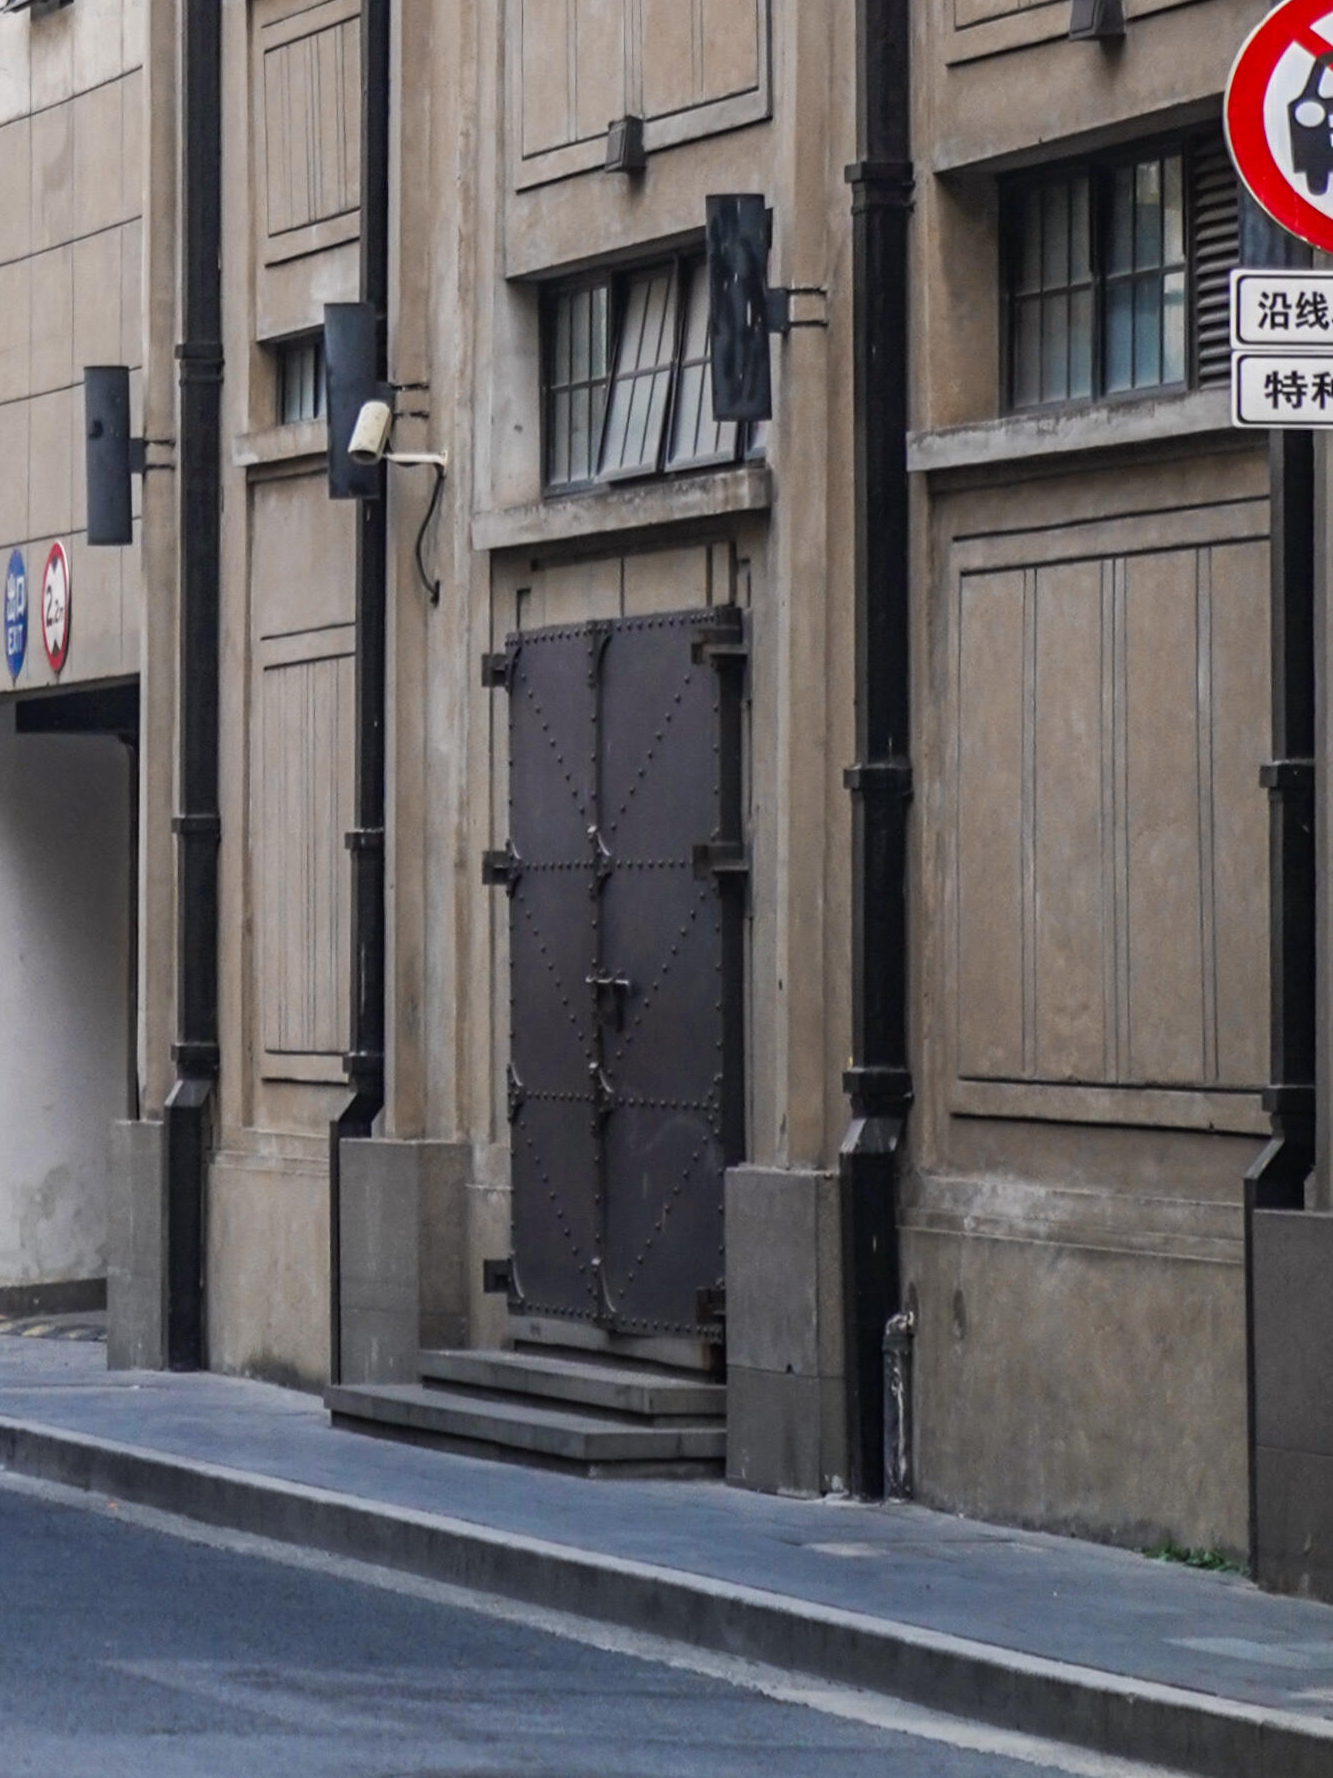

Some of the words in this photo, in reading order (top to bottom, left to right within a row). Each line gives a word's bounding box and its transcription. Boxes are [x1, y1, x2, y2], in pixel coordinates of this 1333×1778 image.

[1258, 291, 1333, 331] 沿线
[7, 573, 25, 622] 出口
[8, 624, 23, 655] EXIT
